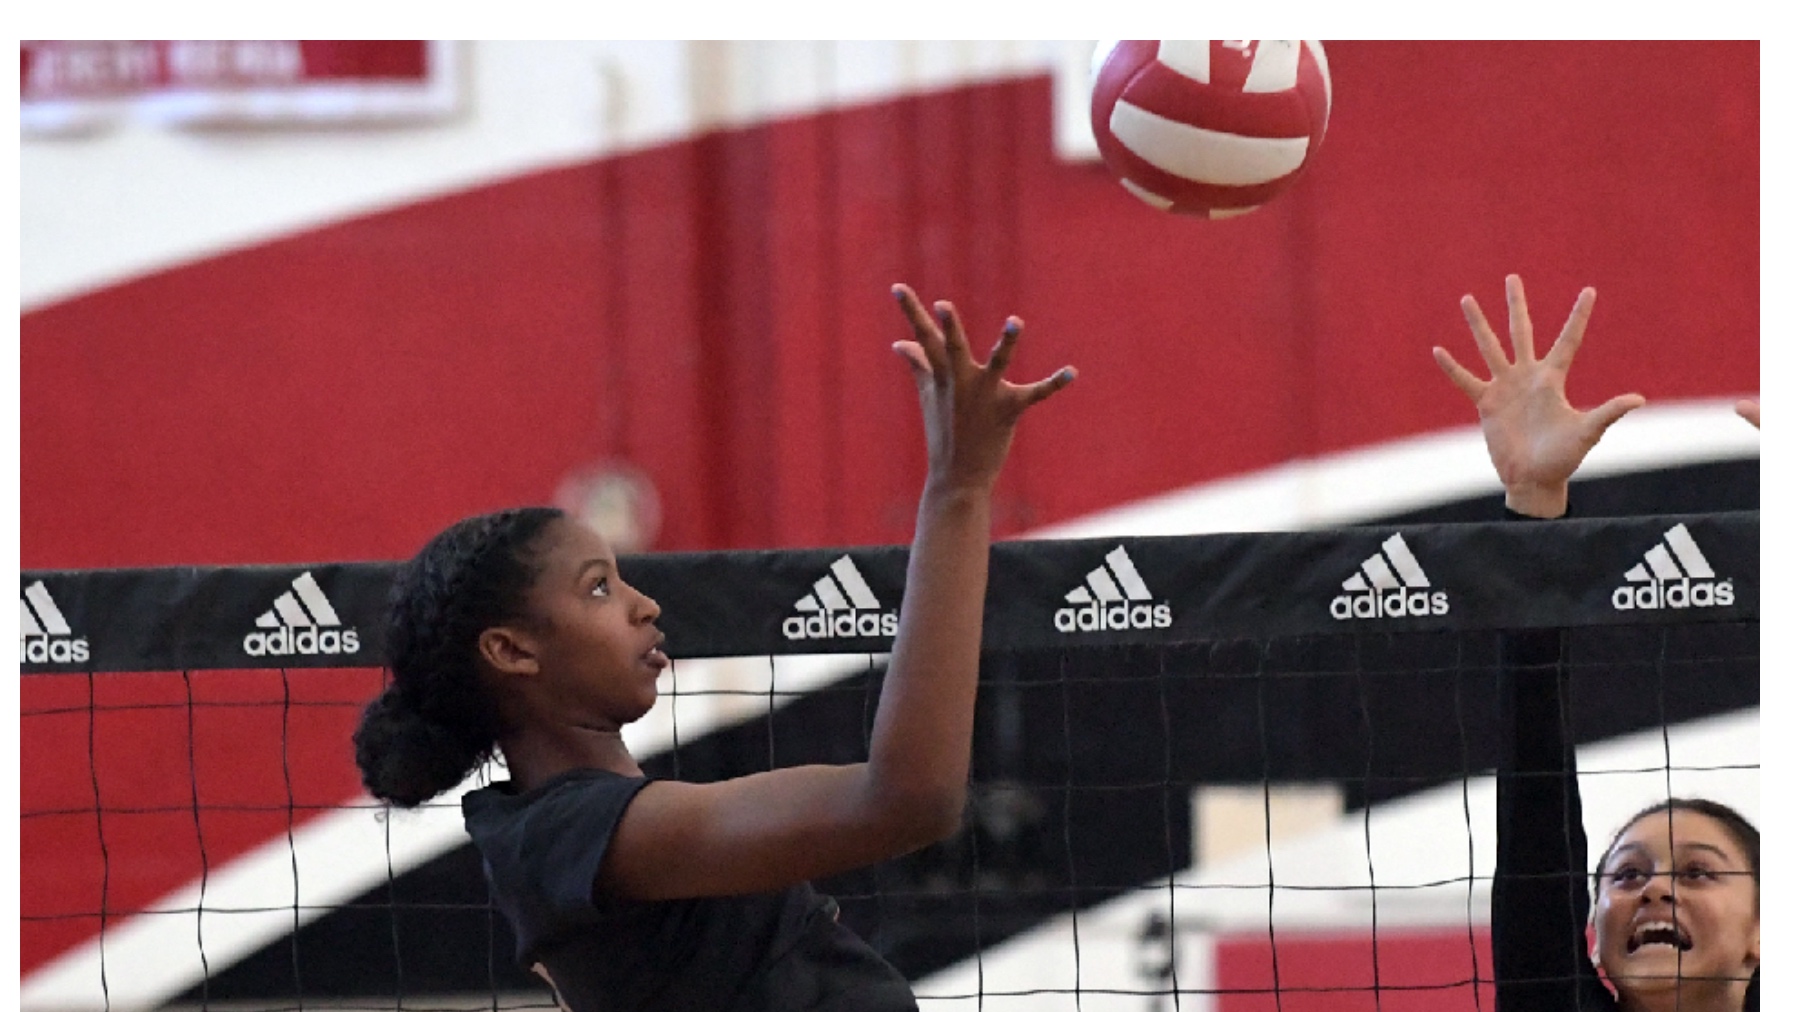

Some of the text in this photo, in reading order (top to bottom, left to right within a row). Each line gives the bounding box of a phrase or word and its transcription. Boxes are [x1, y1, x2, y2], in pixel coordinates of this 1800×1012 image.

[1330, 586, 1449, 620] adidas
[1611, 577, 1735, 610] adidas
[782, 608, 898, 640] adidas
[1054, 601, 1172, 632] adidas
[243, 624, 360, 656] adidas
